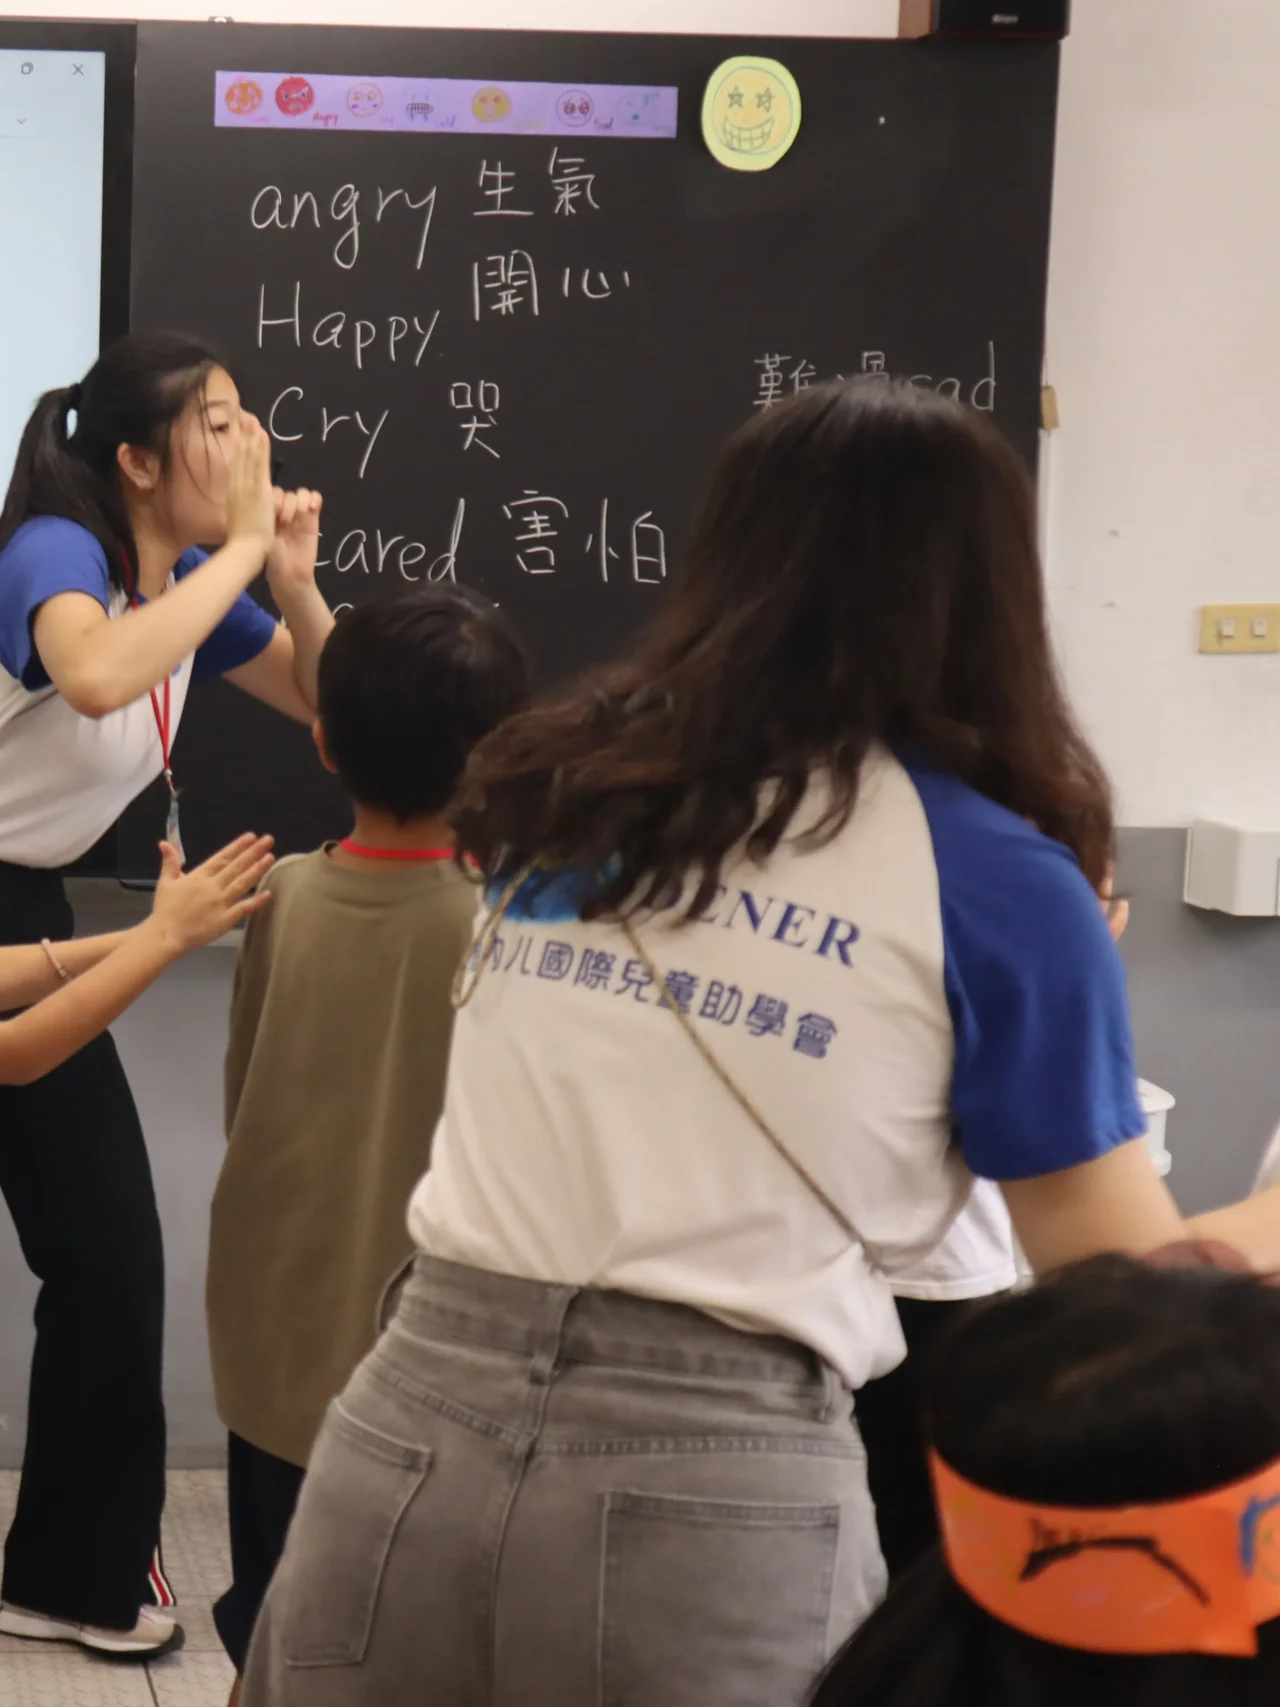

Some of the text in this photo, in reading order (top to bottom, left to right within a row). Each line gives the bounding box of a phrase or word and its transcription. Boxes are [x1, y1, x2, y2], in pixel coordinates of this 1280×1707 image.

[250, 146, 600, 270] angry 生氣
[258, 250, 630, 370] Happy 開心
[269, 380, 501, 479] Cry 哭
[502, 490, 667, 585] 害怕
